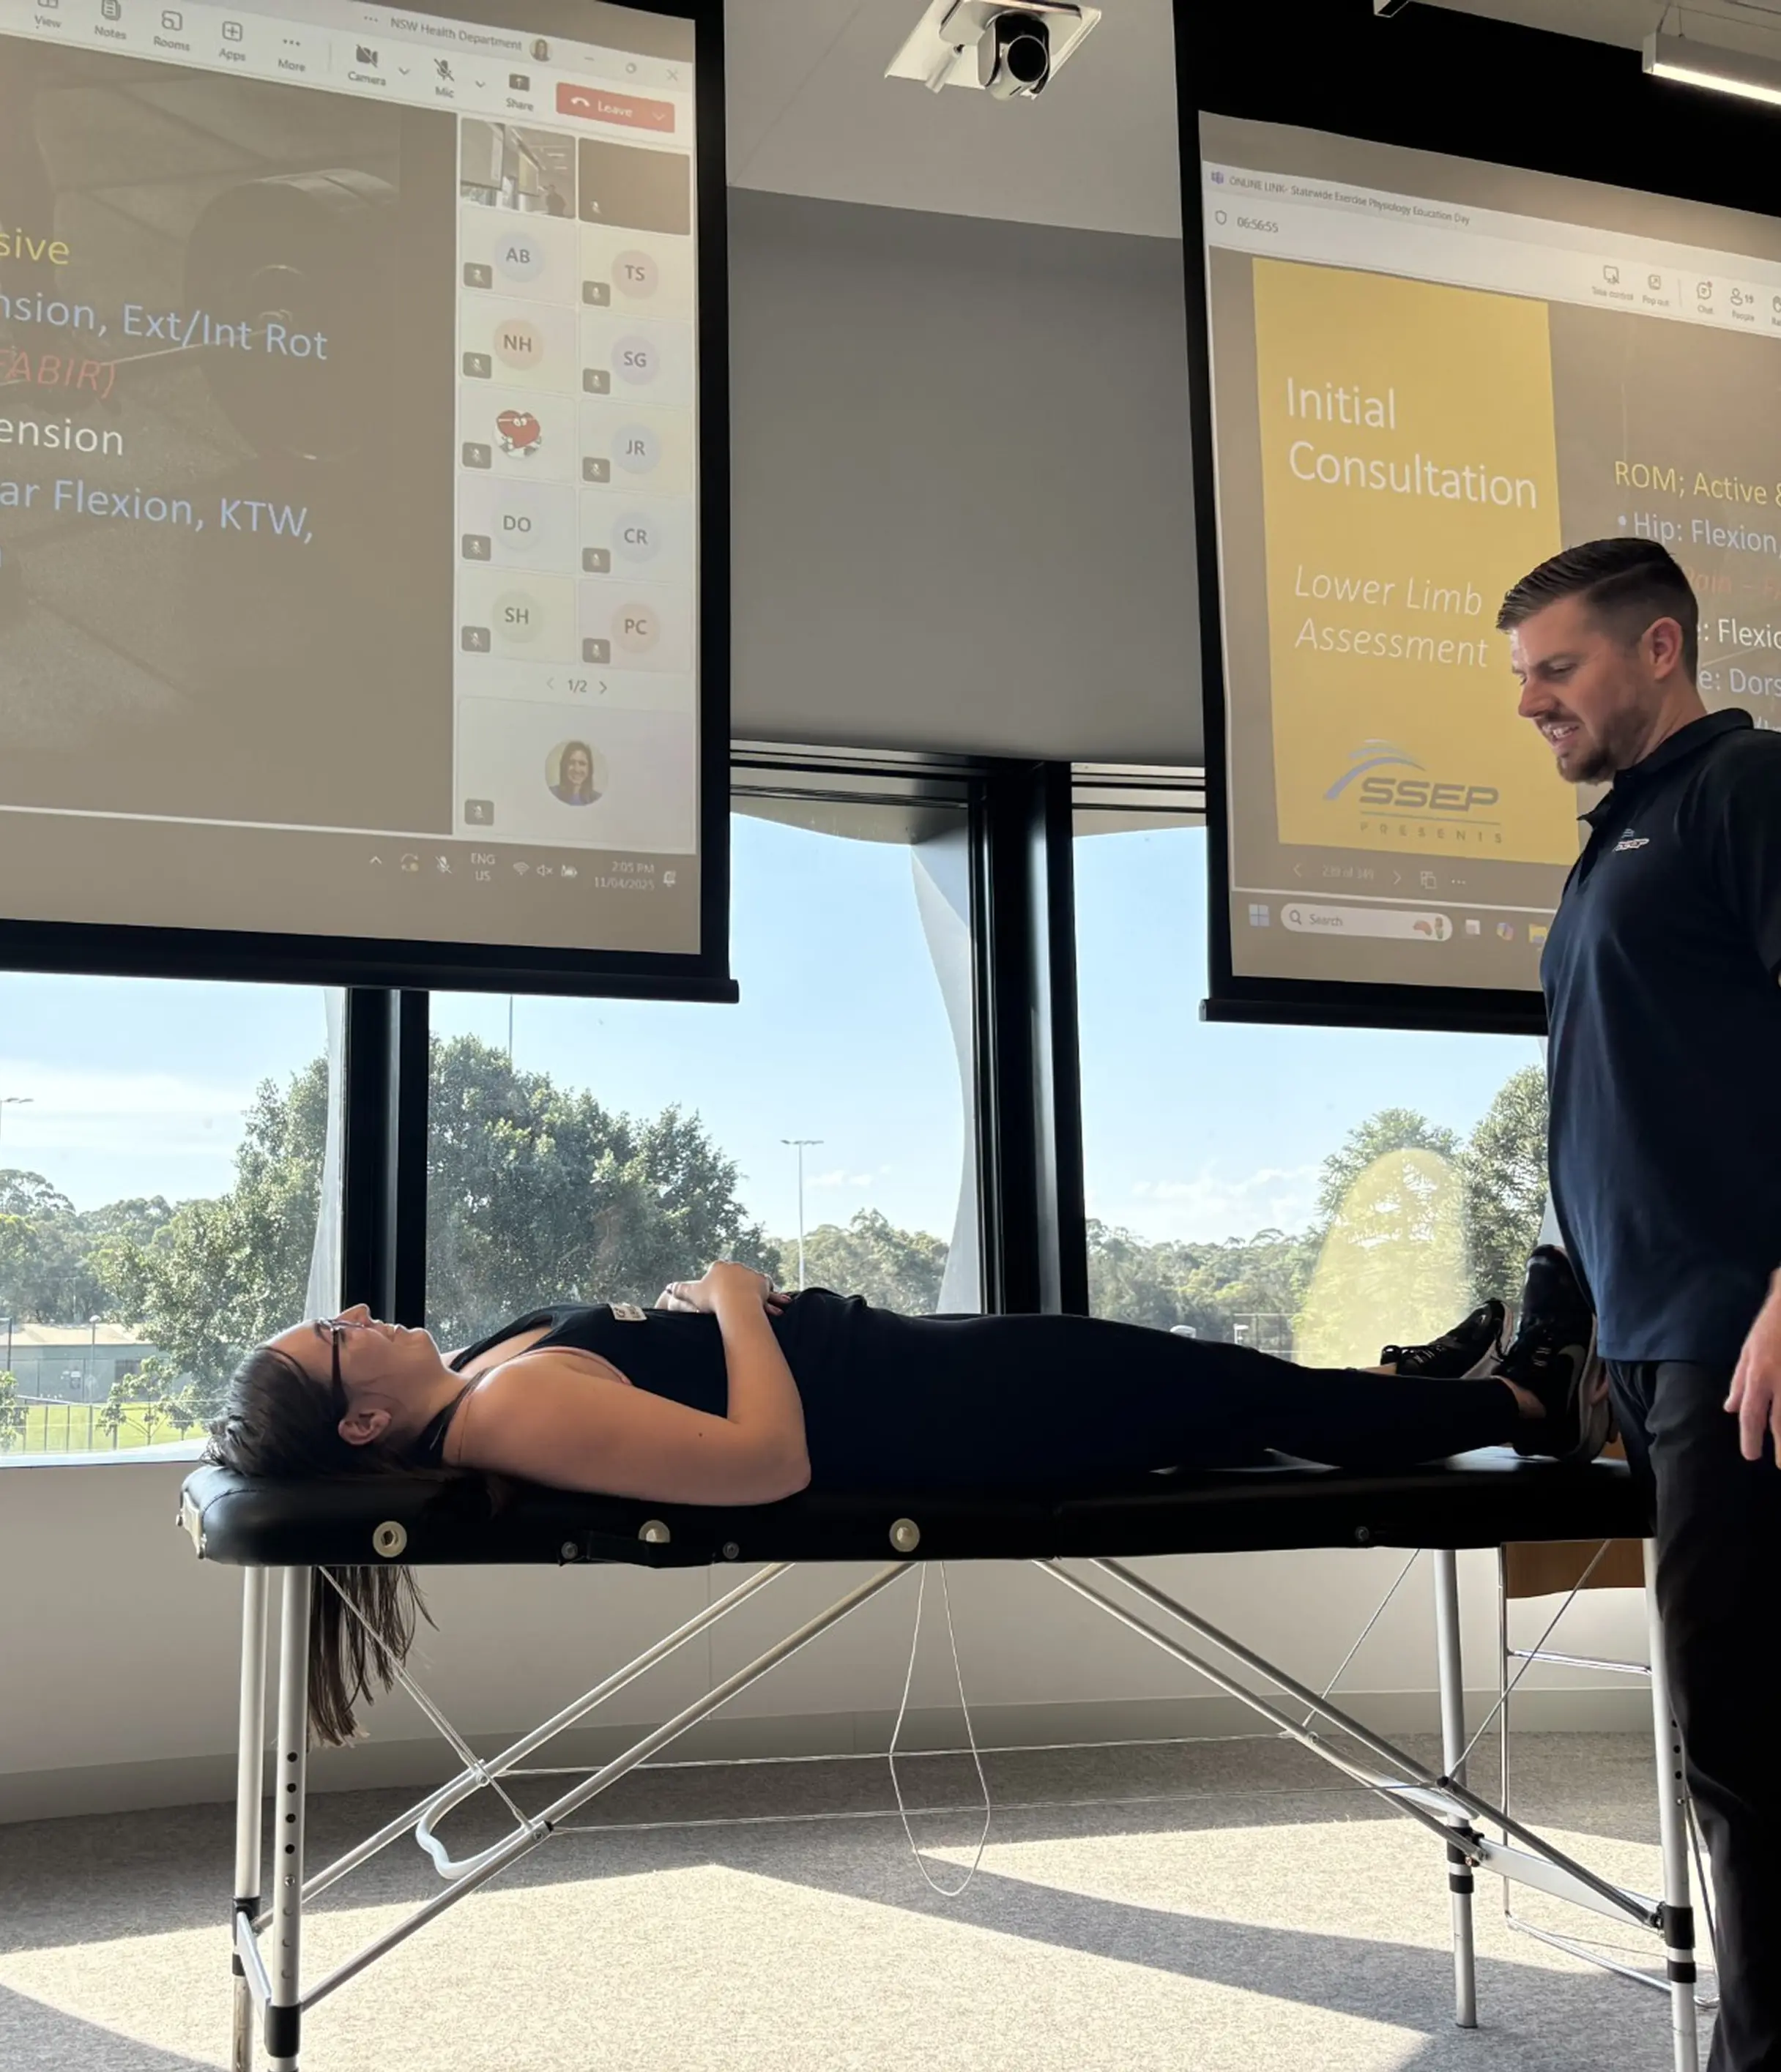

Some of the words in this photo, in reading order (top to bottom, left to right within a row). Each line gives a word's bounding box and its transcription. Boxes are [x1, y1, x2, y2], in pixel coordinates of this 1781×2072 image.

[34, 15, 62, 29] View
[94, 26, 127, 41] Notes
[390, 17, 418, 32] NSW
[420, 22, 456, 40] Health
[458, 29, 522, 51] Department
[153, 36, 190, 52] Rooms
[219, 48, 246, 62] Apps
[278, 59, 306, 72] More
[348, 71, 386, 87] Camera
[436, 86, 454, 99] Mic
[506, 97, 534, 113] Share
[597, 100, 633, 118] Leave
[1229, 176, 1263, 191] ONLINE
[1291, 185, 1333, 201] Statewide
[1334, 191, 1367, 206] Exercise
[1369, 198, 1412, 216] Physiology
[1413, 206, 1451, 221] Education
[1454, 212, 1470, 226] Day
[505, 247, 531, 264] AB
[625, 264, 645, 282] TS
[123, 302, 253, 351] Ext/Int
[266, 322, 328, 360] Rot
[503, 334, 532, 353] NH
[622, 350, 647, 368] SG
[1287, 376, 1396, 431] Initial
[0, 418, 123, 455] ension
[625, 438, 646, 456] JR
[1289, 441, 1537, 509] Consultation
[1615, 461, 1684, 498] ROM;
[1693, 472, 1767, 505] Active
[54, 478, 204, 532] Flexion,
[220, 497, 313, 544] KTW,
[503, 514, 532, 533] DO
[1634, 512, 1682, 546] Hip:
[624, 528, 648, 545] CR
[1295, 564, 1396, 606] Lower
[1406, 576, 1483, 616] Limb
[505, 607, 529, 625] SH
[625, 618, 647, 636] PC
[1295, 617, 1489, 668] Assessment
[567, 678, 587, 693] 1/2
[1358, 777, 1499, 812] SSEP
[1360, 821, 1502, 843] PRESENTS
[471, 852, 496, 865] ENG
[475, 871, 491, 882] US
[1309, 914, 1343, 928] Search
